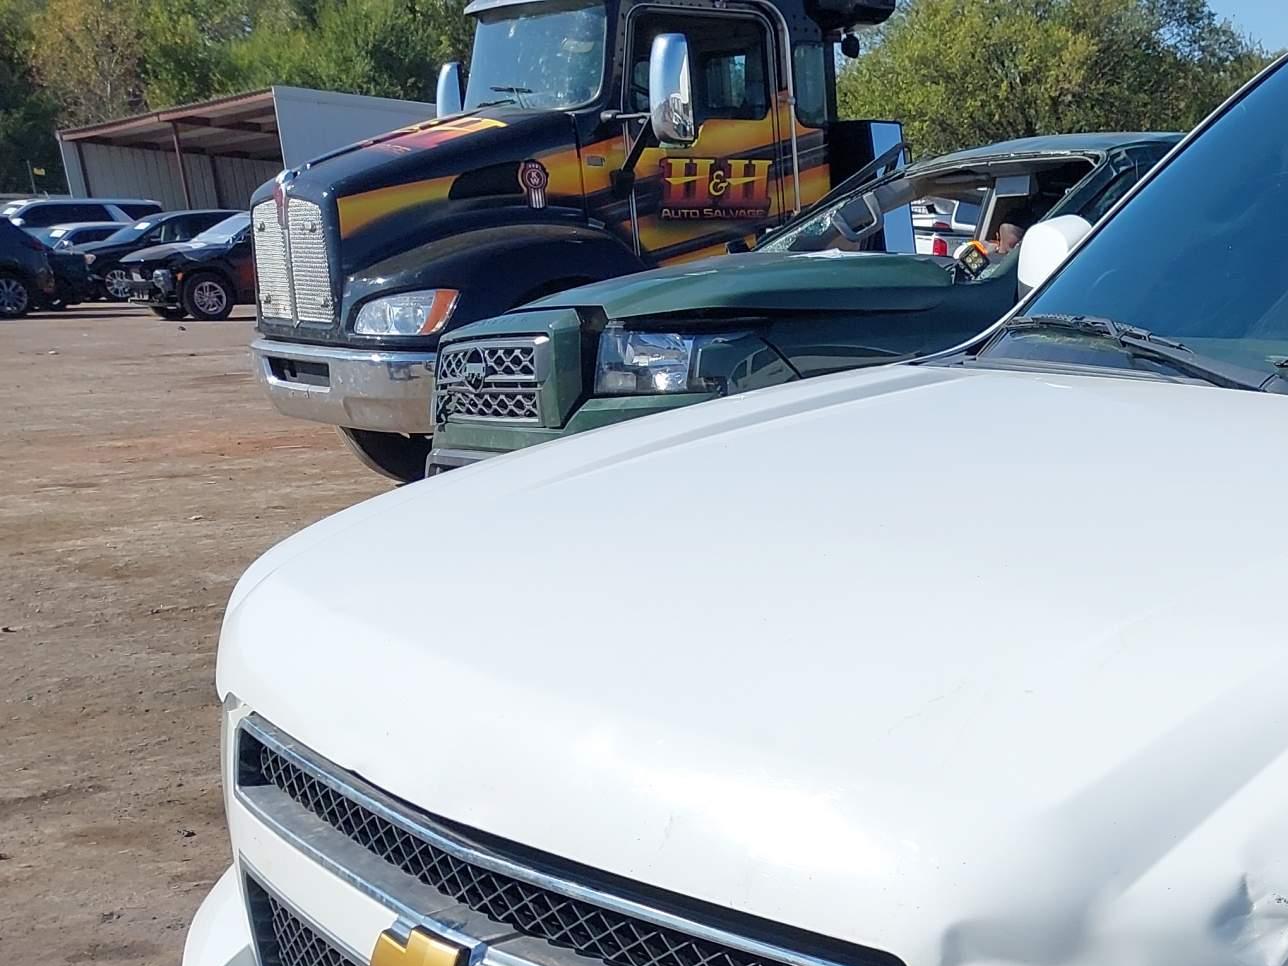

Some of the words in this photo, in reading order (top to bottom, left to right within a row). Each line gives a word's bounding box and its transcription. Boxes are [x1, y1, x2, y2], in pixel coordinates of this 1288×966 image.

[665, 157, 774, 207] H&H
[661, 208, 700, 219] AUTO
[703, 208, 767, 219] SALVAGE
